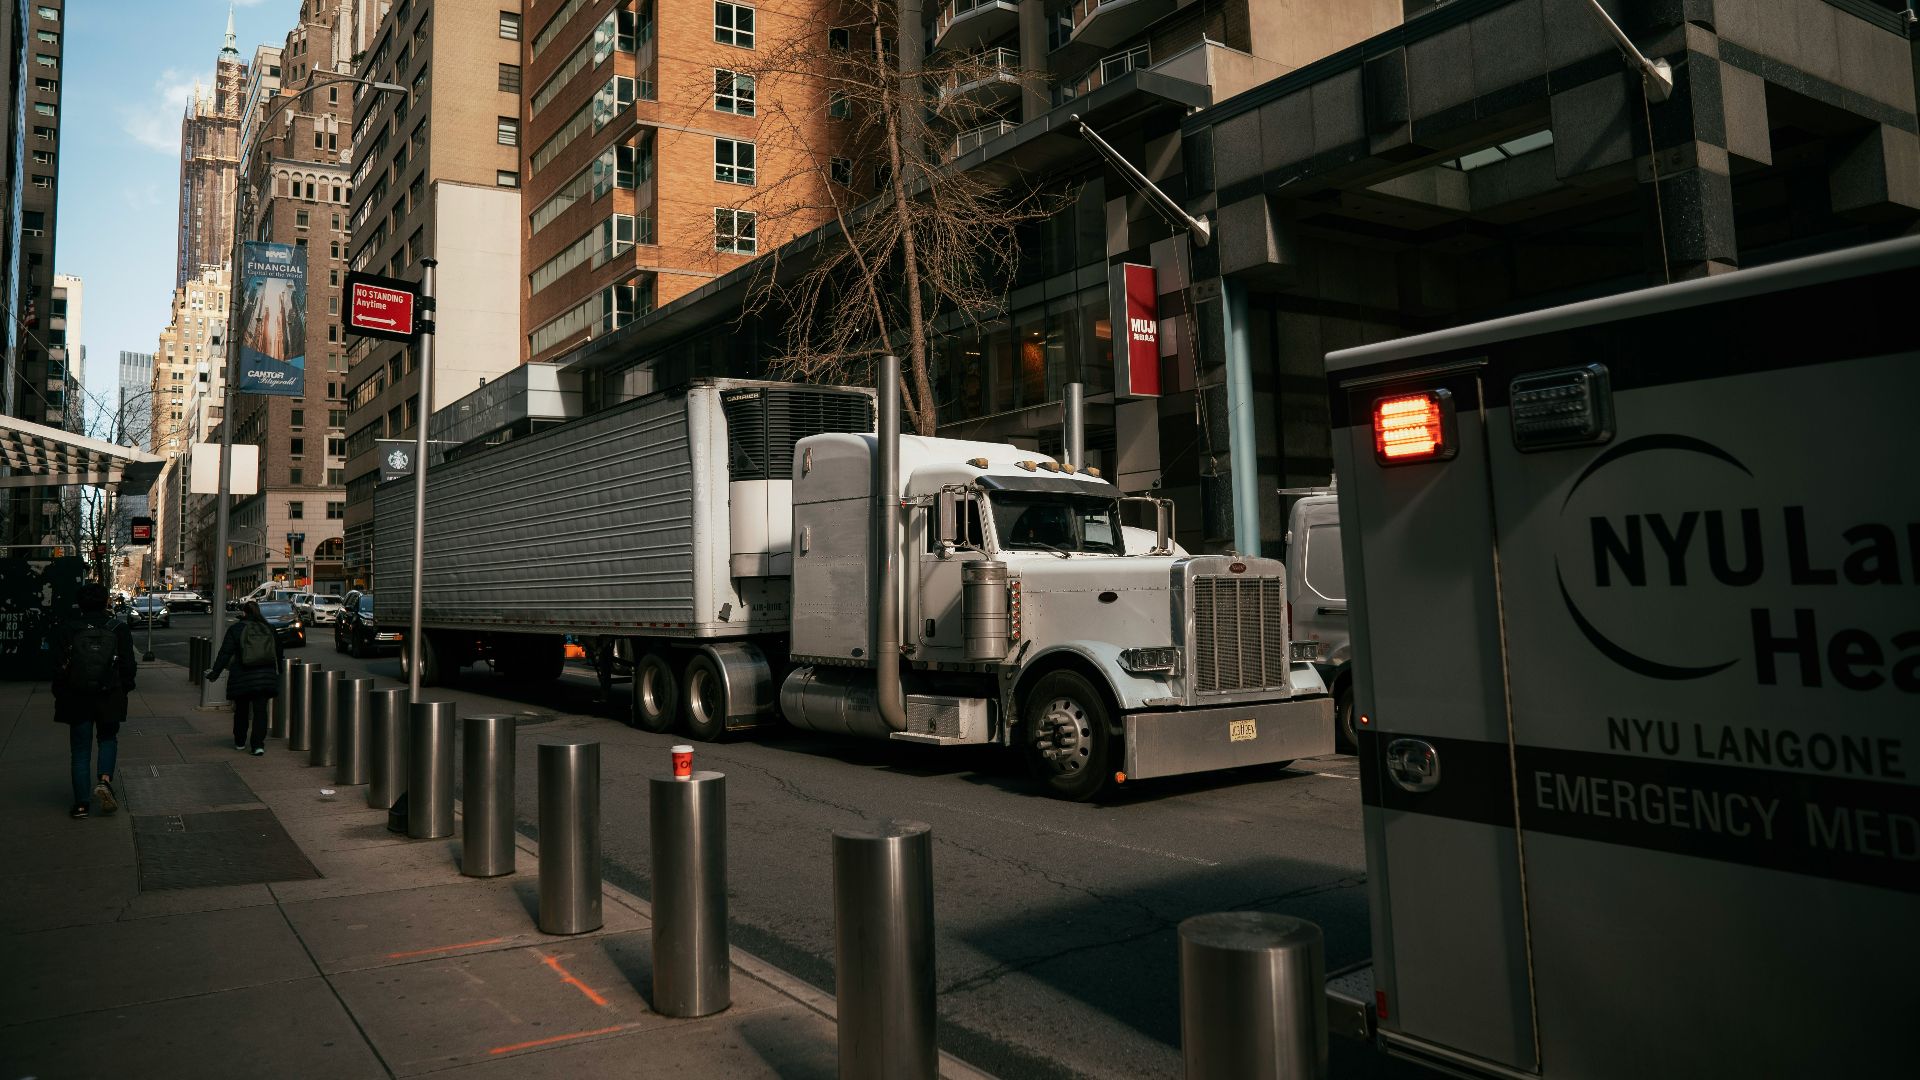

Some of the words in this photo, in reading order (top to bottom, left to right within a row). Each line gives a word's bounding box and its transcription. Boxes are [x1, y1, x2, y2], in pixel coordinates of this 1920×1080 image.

[247, 262, 303, 274] FINANCIAL
[356, 288, 368, 297] NO
[368, 290, 404, 304] STANDING
[356, 298, 387, 310] Anytime
[1130, 318, 1157, 334] MUJI
[247, 370, 285, 379] CANTOR
[726, 392, 760, 402] CARRIER
[1589, 508, 1765, 587] NYU
[0, 613, 24, 621] POST
[6, 622, 18, 630] NO
[1607, 716, 1681, 756] NYU
[1694, 723, 1906, 779] LANGONE
[1533, 769, 1780, 841] EMERGENCY
[1804, 800, 1920, 862] MED
